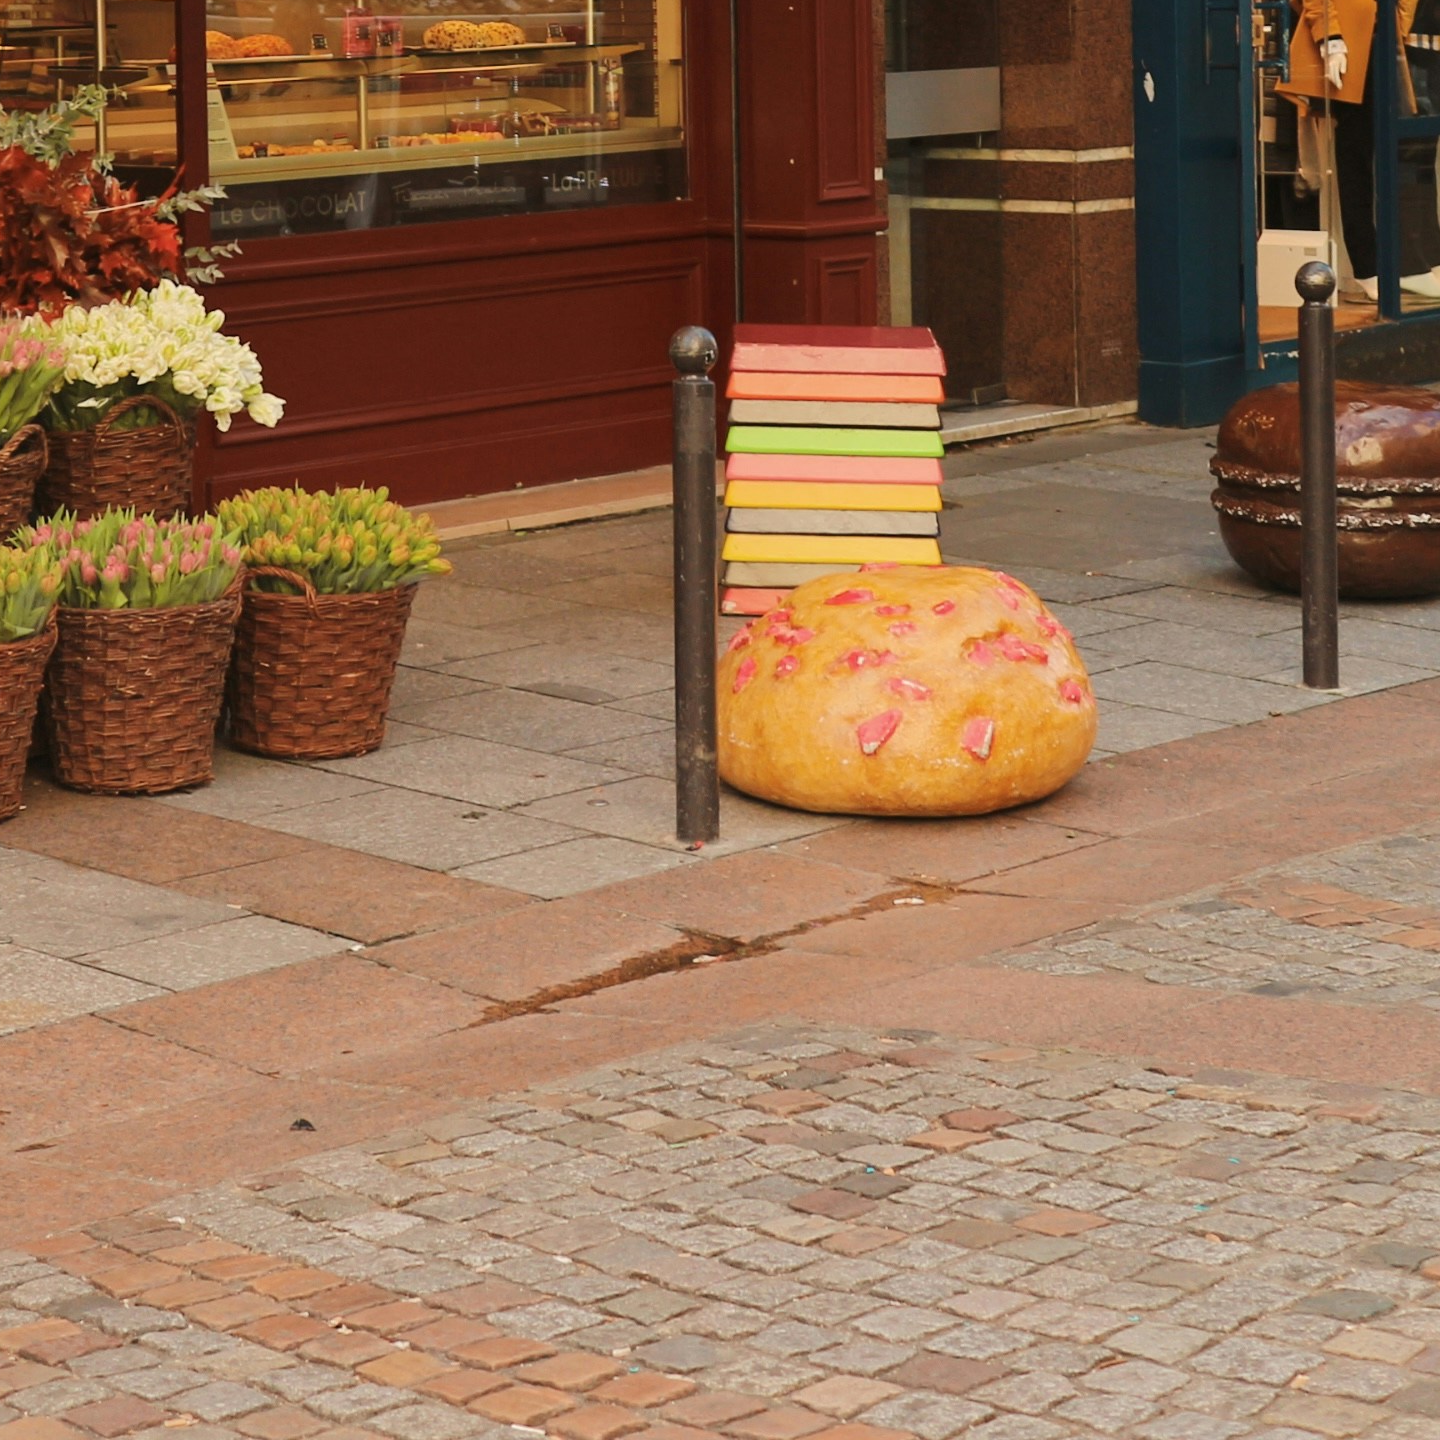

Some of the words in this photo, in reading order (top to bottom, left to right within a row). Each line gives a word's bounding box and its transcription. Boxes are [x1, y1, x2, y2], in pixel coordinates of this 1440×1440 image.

[552, 172, 571, 193] La
[220, 204, 243, 225] Le
[251, 191, 367, 221] CHOCOLAT
